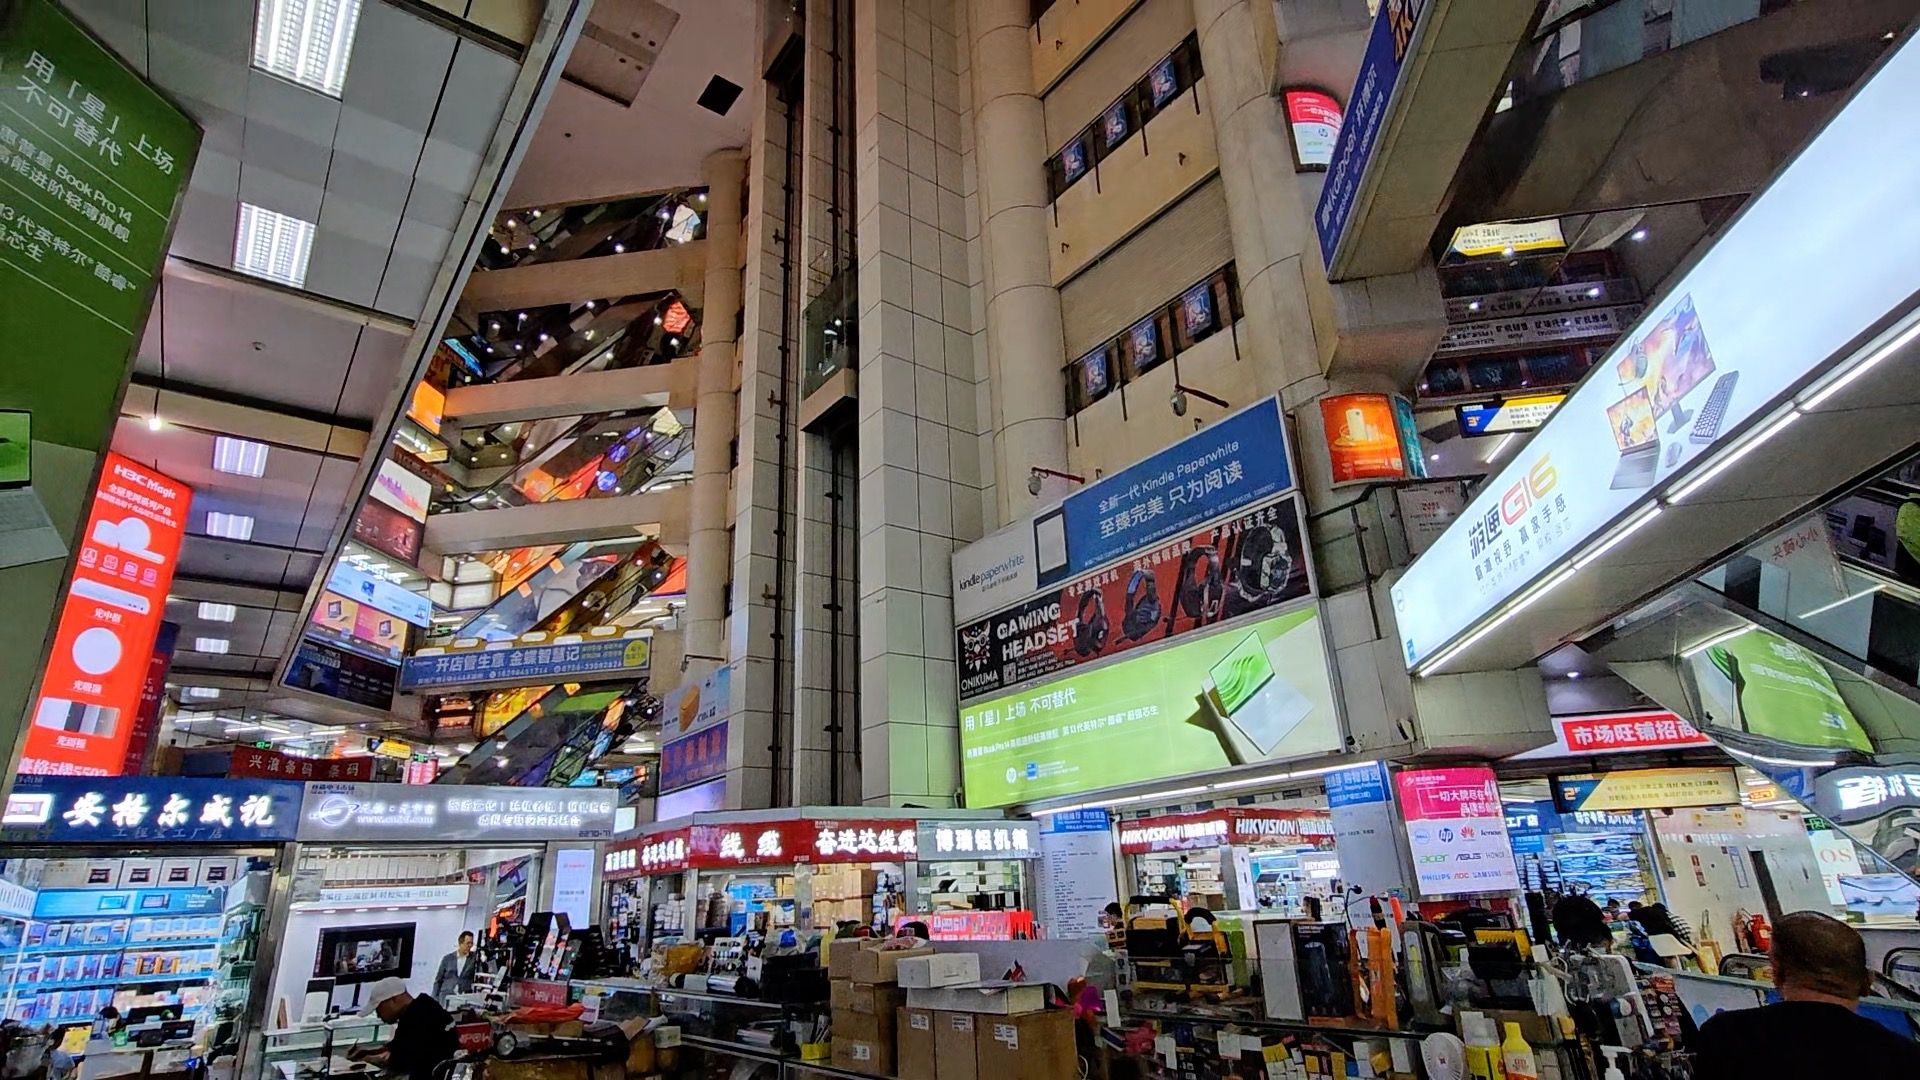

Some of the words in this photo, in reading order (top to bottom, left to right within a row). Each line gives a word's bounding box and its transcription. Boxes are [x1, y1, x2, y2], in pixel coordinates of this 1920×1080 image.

[17, 75, 123, 166] 不可替代
[55, 164, 92, 197] Book
[93, 188, 117, 213] Pro
[118, 205, 132, 224] 14
[1098, 484, 1139, 513] 全新一代
[1142, 468, 1175, 493] Kindle
[1177, 441, 1239, 477] Paperwhite
[1100, 495, 1165, 538] 至臻完美
[1169, 460, 1243, 510] 只为阅读
[1210, 507, 1278, 543] 产品认证齐全
[996, 603, 1062, 640] GAMING
[1001, 621, 1080, 661] HEADSET
[435, 652, 504, 672] 开店管生意
[961, 671, 999, 690] ONIKUMA
[964, 701, 1026, 732] 用「星」上场
[1030, 687, 1076, 713] 不可替代
[1572, 719, 1699, 746] 市场旺铺招商
[63, 792, 275, 828] 安格尔威视
[815, 828, 917, 855] 奋进达线缆
[1121, 825, 1182, 845] HIKVISION
[1235, 818, 1297, 835] HIKVISION
[719, 829, 783, 858] 线缆
[1420, 854, 1448, 864] acer
[1456, 852, 1482, 861] ASUS
[1421, 872, 1450, 881] PHILIPS
[1454, 871, 1470, 879] AOC
